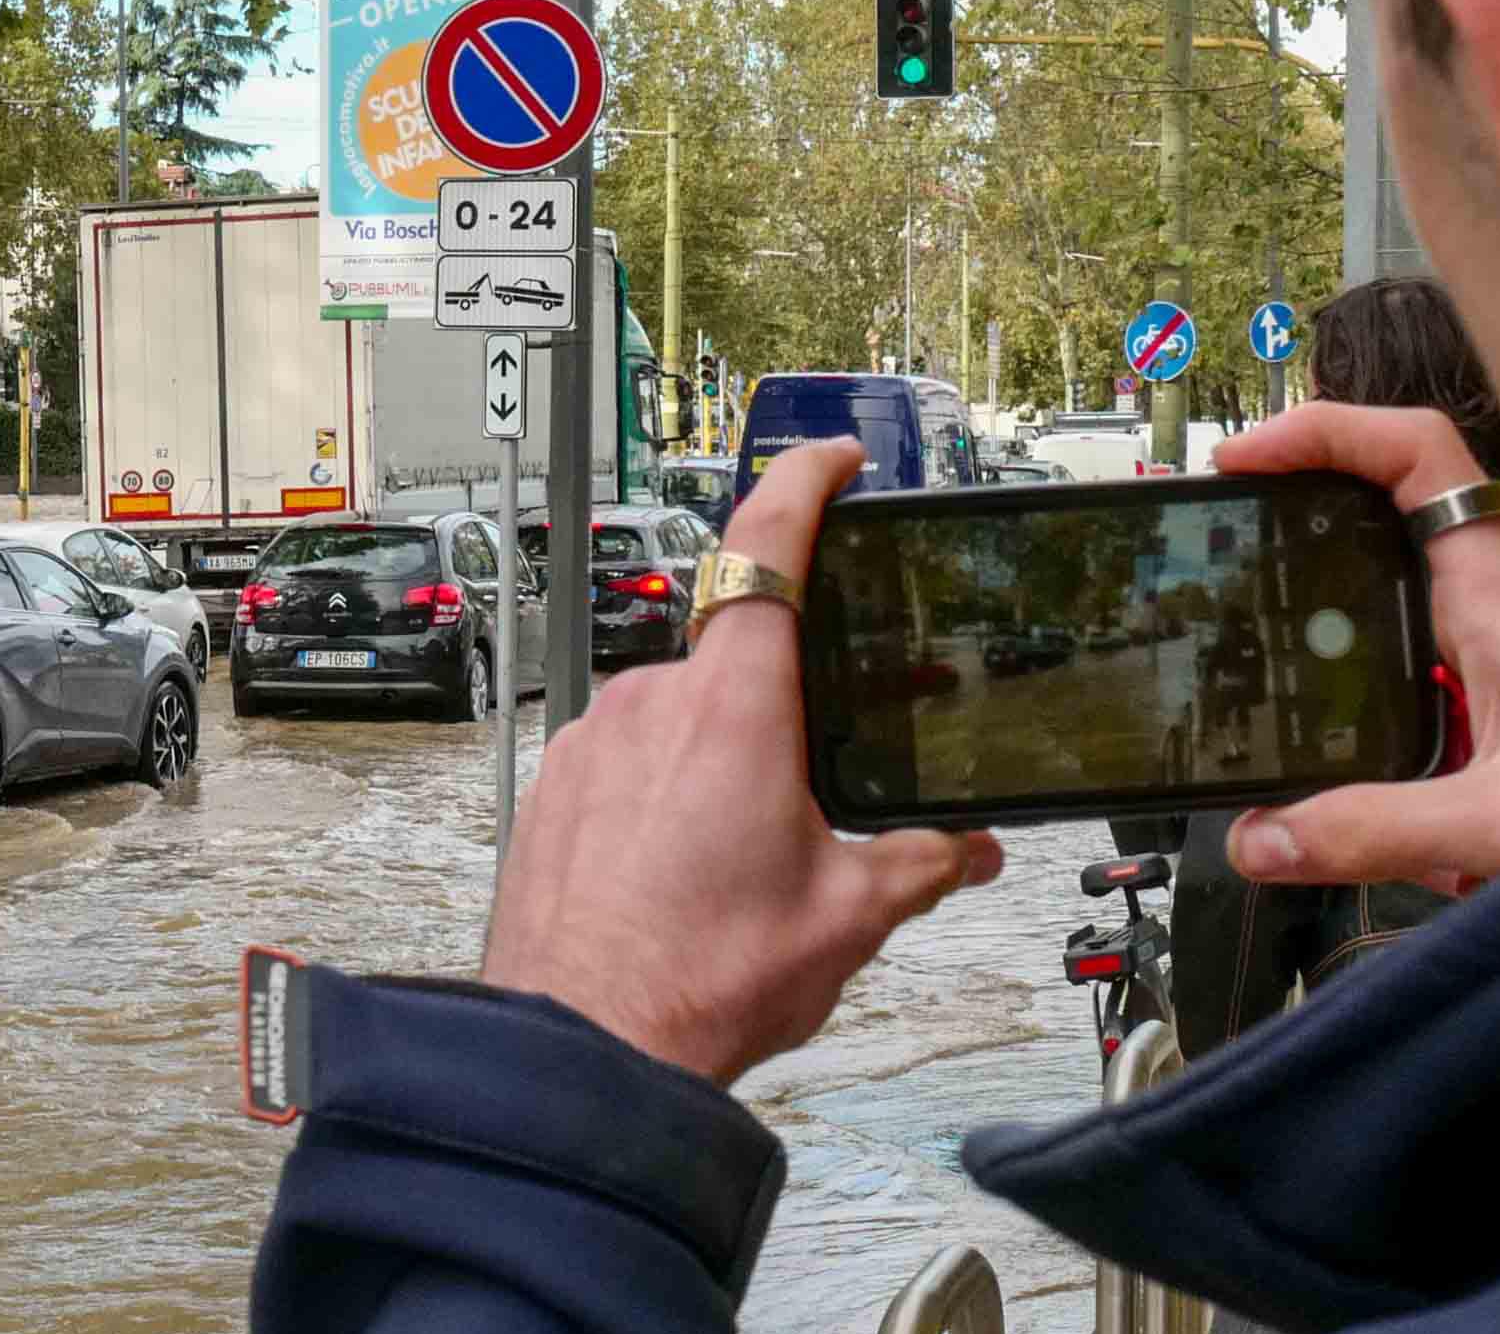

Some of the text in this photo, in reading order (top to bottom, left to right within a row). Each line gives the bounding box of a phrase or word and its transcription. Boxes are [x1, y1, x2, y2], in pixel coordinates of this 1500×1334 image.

[368, 80, 421, 123] SCU
[395, 107, 431, 140] DE
[377, 136, 443, 179] INFA
[345, 218, 437, 240] Via Bosch
[455, 200, 478, 230] 0
[510, 200, 556, 230] 24
[307, 652, 366, 666] EP 106CS
